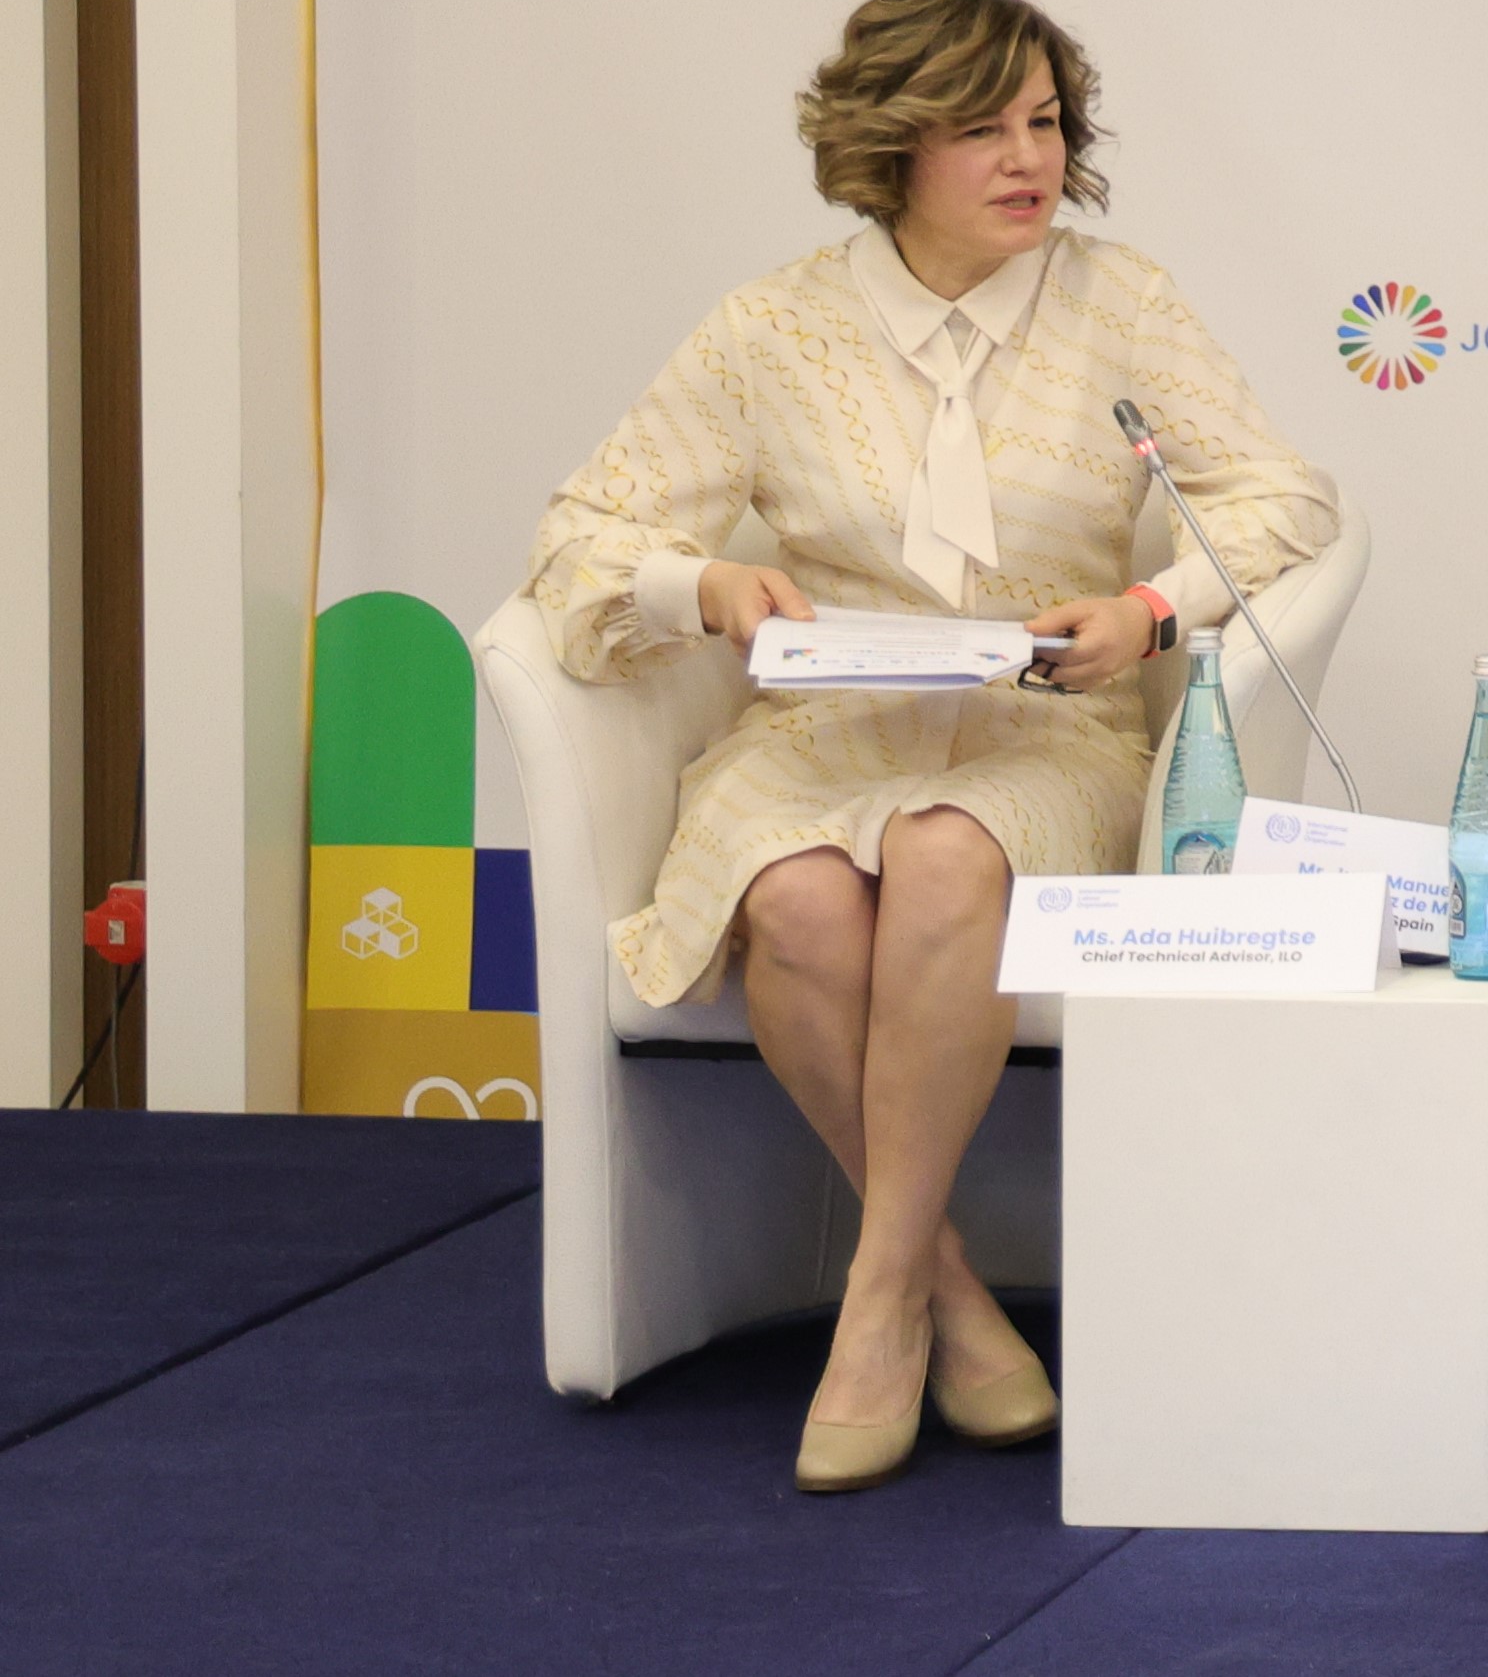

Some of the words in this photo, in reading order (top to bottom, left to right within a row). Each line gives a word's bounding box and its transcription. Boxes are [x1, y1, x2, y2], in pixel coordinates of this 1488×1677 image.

[1387, 875, 1449, 896] Manue
[1403, 896, 1427, 912] de
[1074, 930, 1114, 945] Ms.
[1122, 929, 1171, 944] Ada
[1178, 927, 1315, 950] Huibregtse
[1082, 951, 1124, 962] Chief
[1128, 951, 1205, 962] Technical
[1209, 951, 1273, 962] Advisor,
[1279, 951, 1302, 962] ILO
